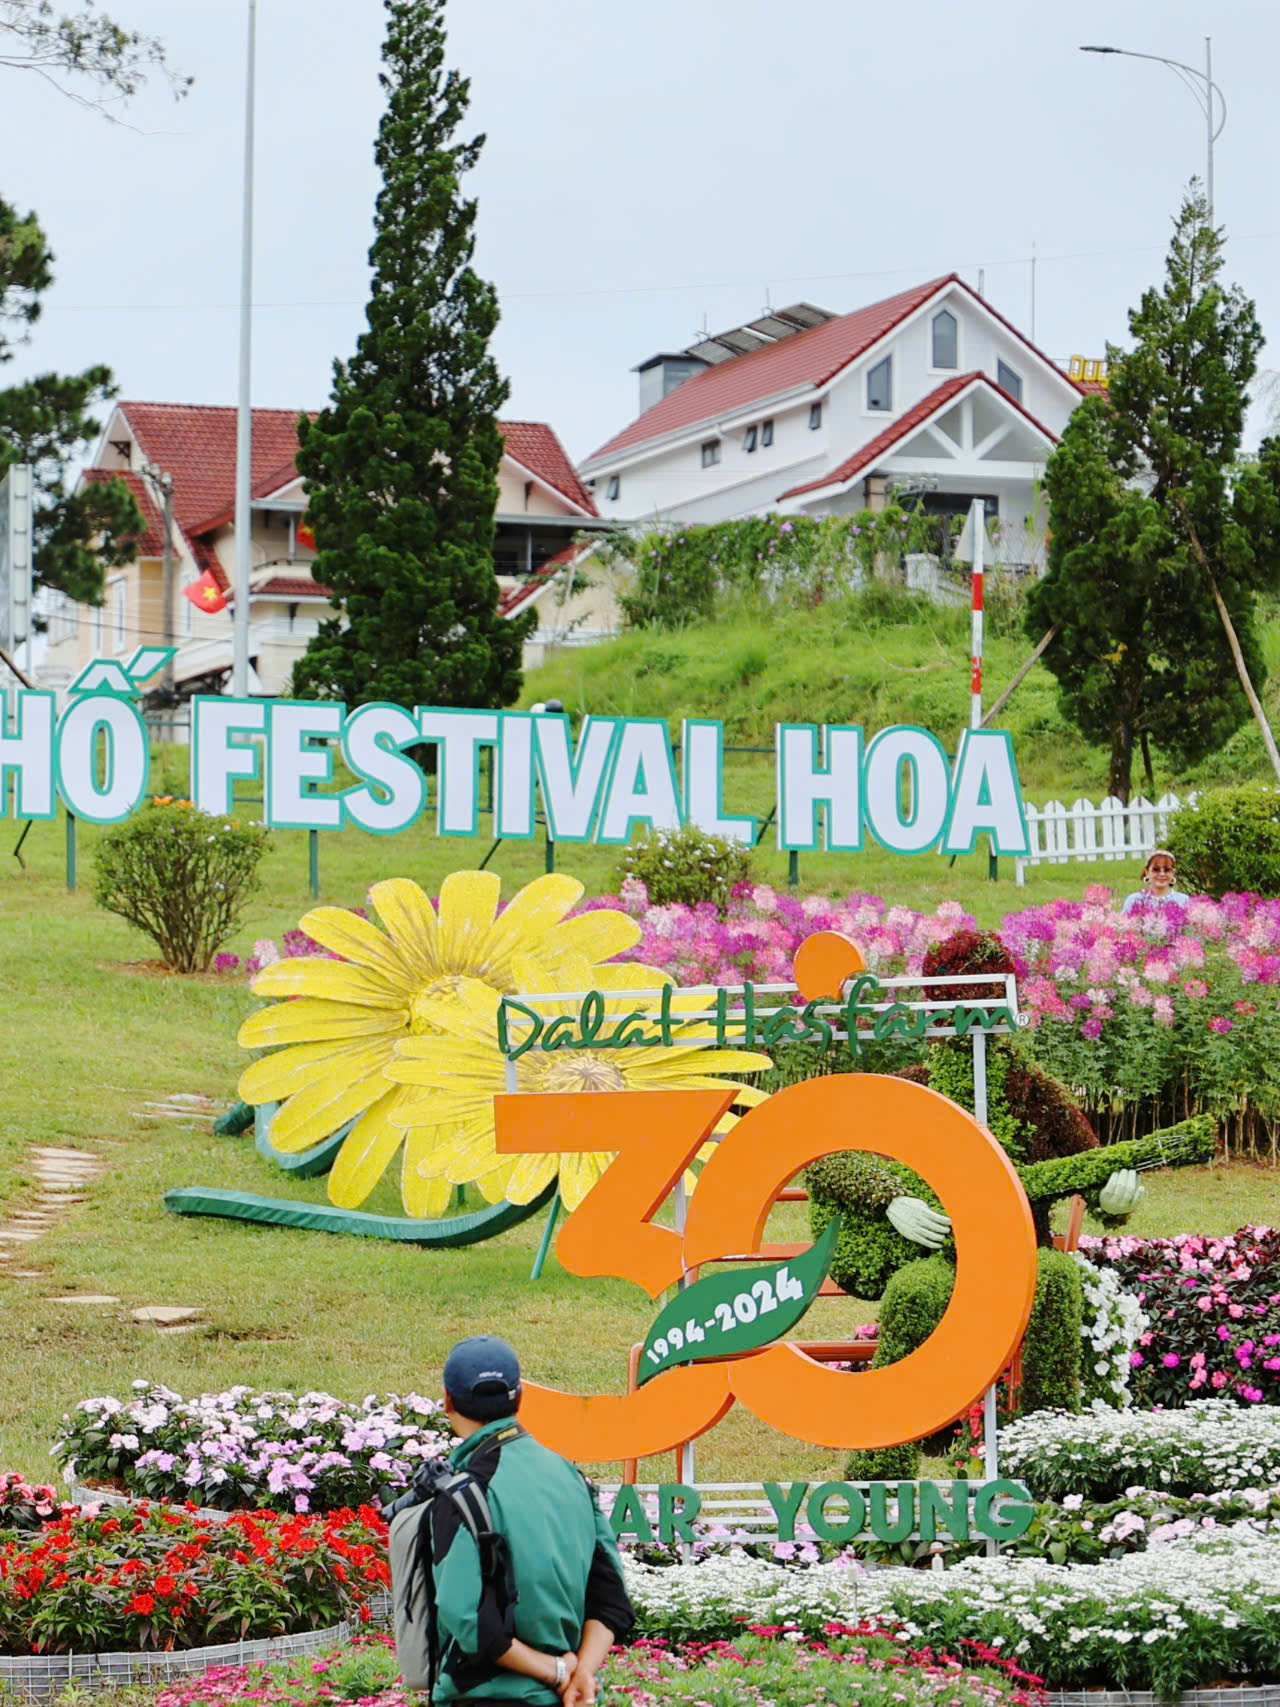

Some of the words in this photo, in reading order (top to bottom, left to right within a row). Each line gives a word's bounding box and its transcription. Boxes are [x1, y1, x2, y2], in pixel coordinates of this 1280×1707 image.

[190, 694, 758, 847] FESTIVAL
[775, 722, 1031, 856] HOA
[497, 983, 684, 1061] Dalat
[493, 1072, 1038, 1462] 30
[645, 1265, 804, 1366] 1994-2024
[594, 1483, 703, 1543] AR
[762, 1478, 1035, 1542] YOUNG
